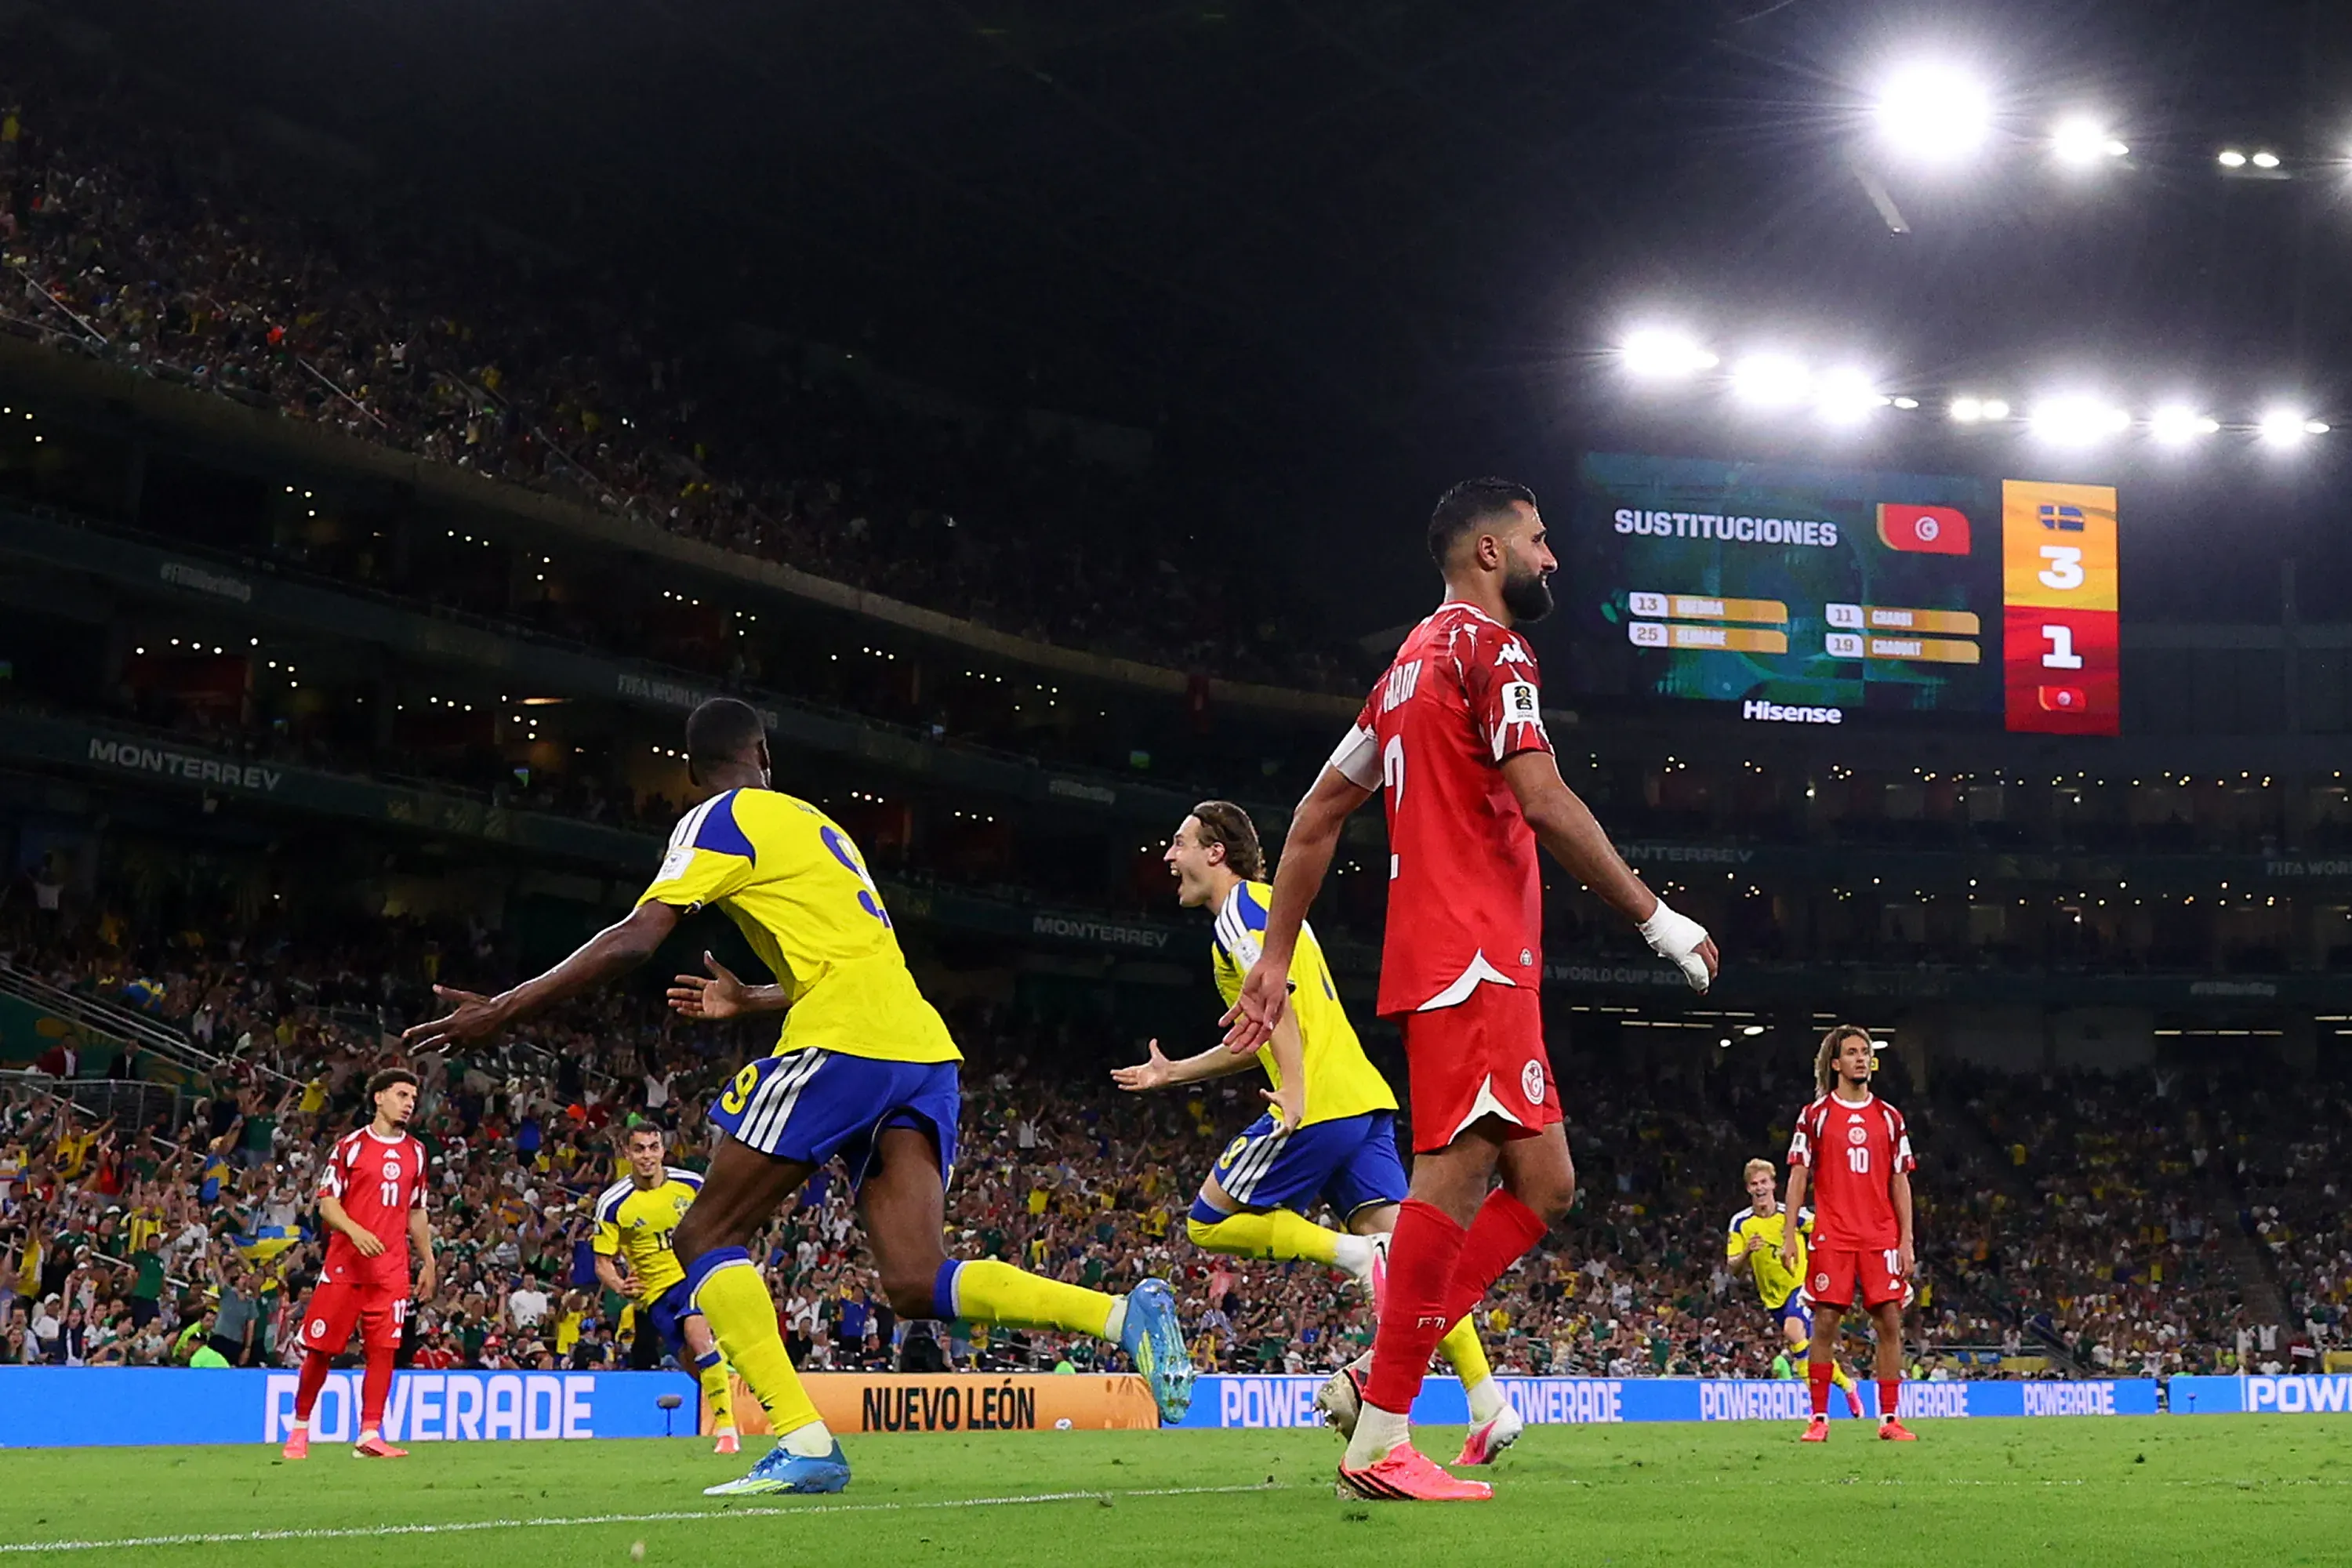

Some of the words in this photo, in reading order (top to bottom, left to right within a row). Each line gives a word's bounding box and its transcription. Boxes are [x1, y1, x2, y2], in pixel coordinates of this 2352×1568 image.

[1614, 509, 1838, 547] SUSTITUCIONES
[2038, 545, 2085, 590] 3
[1638, 597, 1658, 611] 13
[1835, 609, 1853, 622] 11
[1636, 627, 1658, 641] 25
[1835, 638, 1853, 652] 19
[2042, 625, 2082, 669] 1
[1744, 700, 1842, 724] Hisense
[88, 738, 281, 792] MONTERREY
[1618, 843, 1755, 864] ONTERREY
[1033, 916, 1169, 948] MONTERREY
[1555, 964, 1612, 982] WORLD
[1614, 967, 1649, 984] CUP
[720, 1062, 758, 1115] 9
[1846, 1146, 1869, 1174] 10
[380, 1181, 399, 1207] 11
[393, 1298, 408, 1324] 11
[862, 1386, 960, 1432] NUEVO
[967, 1377, 1036, 1430] LEÓN
[1700, 1382, 1812, 1421] POWERADE
[2023, 1381, 2116, 1416] POWERADE
